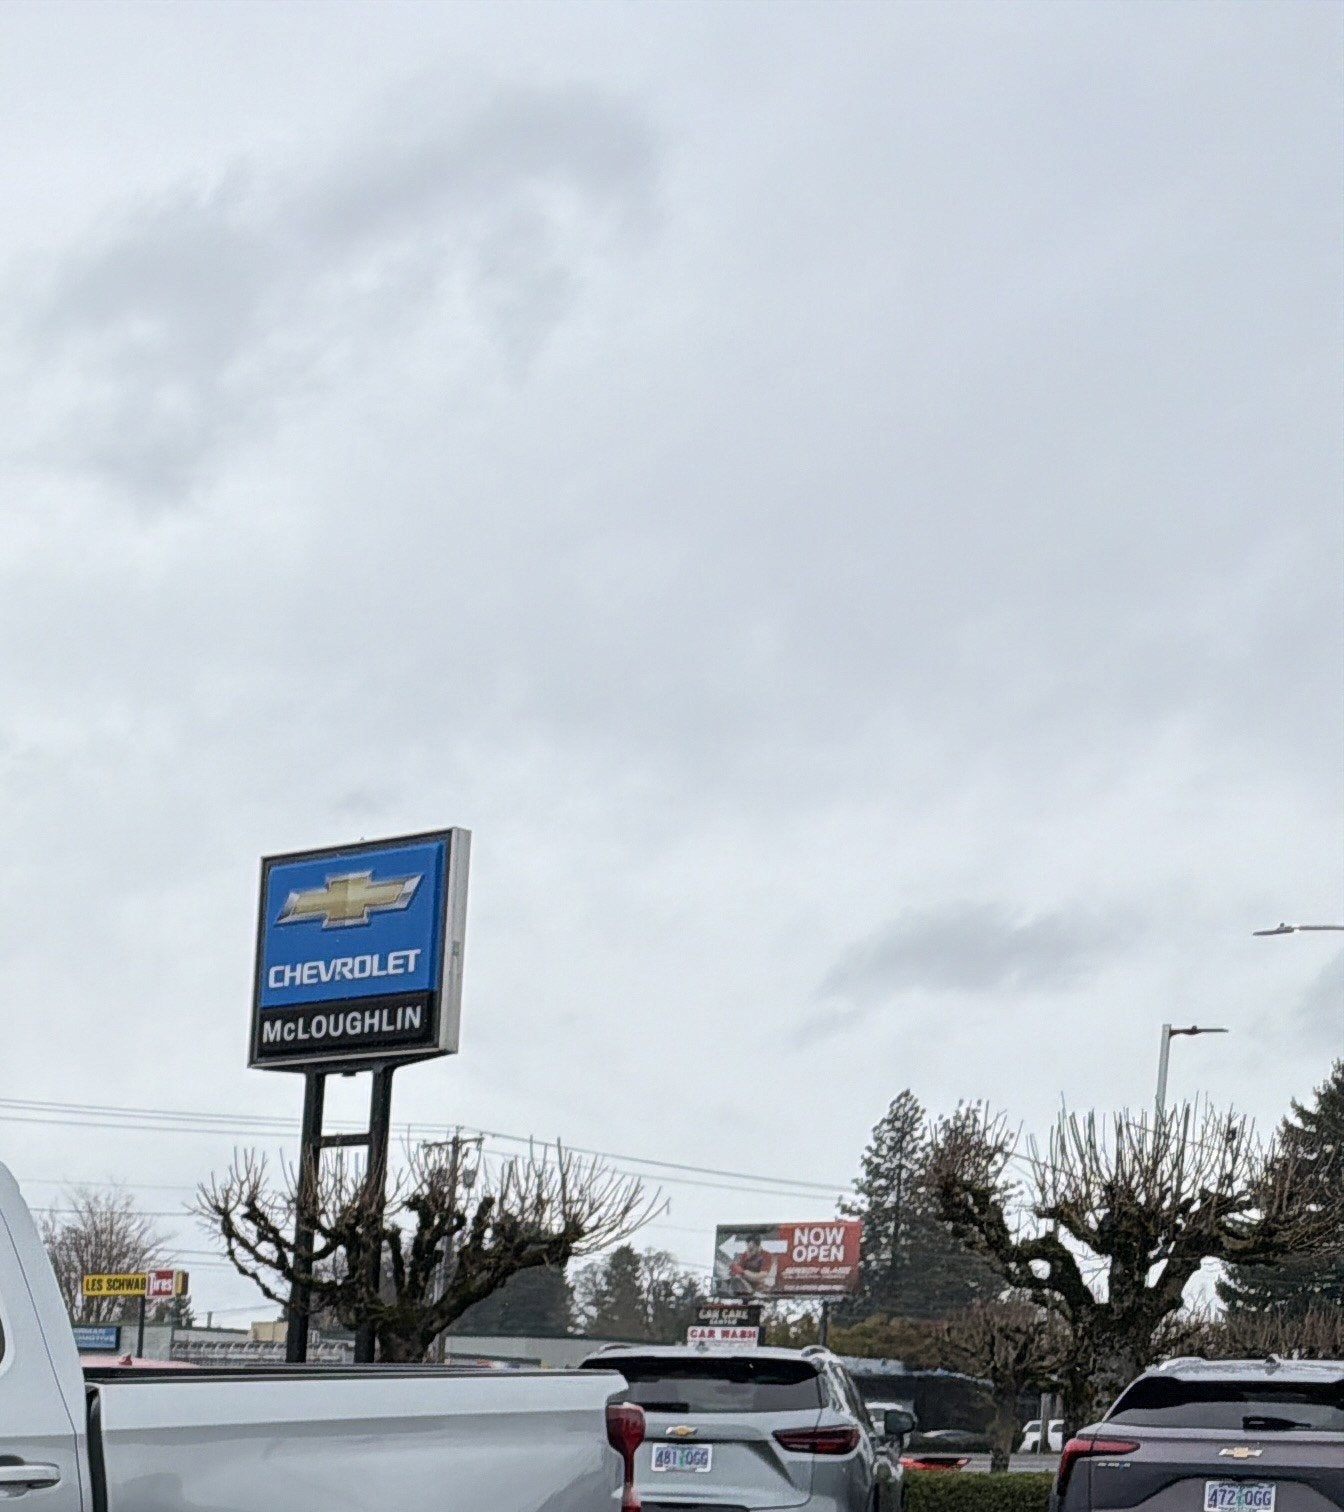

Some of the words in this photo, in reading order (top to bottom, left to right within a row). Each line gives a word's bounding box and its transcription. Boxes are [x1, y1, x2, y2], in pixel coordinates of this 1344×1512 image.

[268, 949, 421, 988] CHEVROLET
[262, 1005, 422, 1043] McLOUGHLIN
[793, 1227, 845, 1246] NOW
[792, 1245, 845, 1263] OPEN
[85, 1278, 103, 1291] LES
[106, 1278, 146, 1291] SCHWAB
[690, 1329, 716, 1338] CAR
[720, 1329, 756, 1339] WASH
[1209, 1489, 1235, 1506] 472
